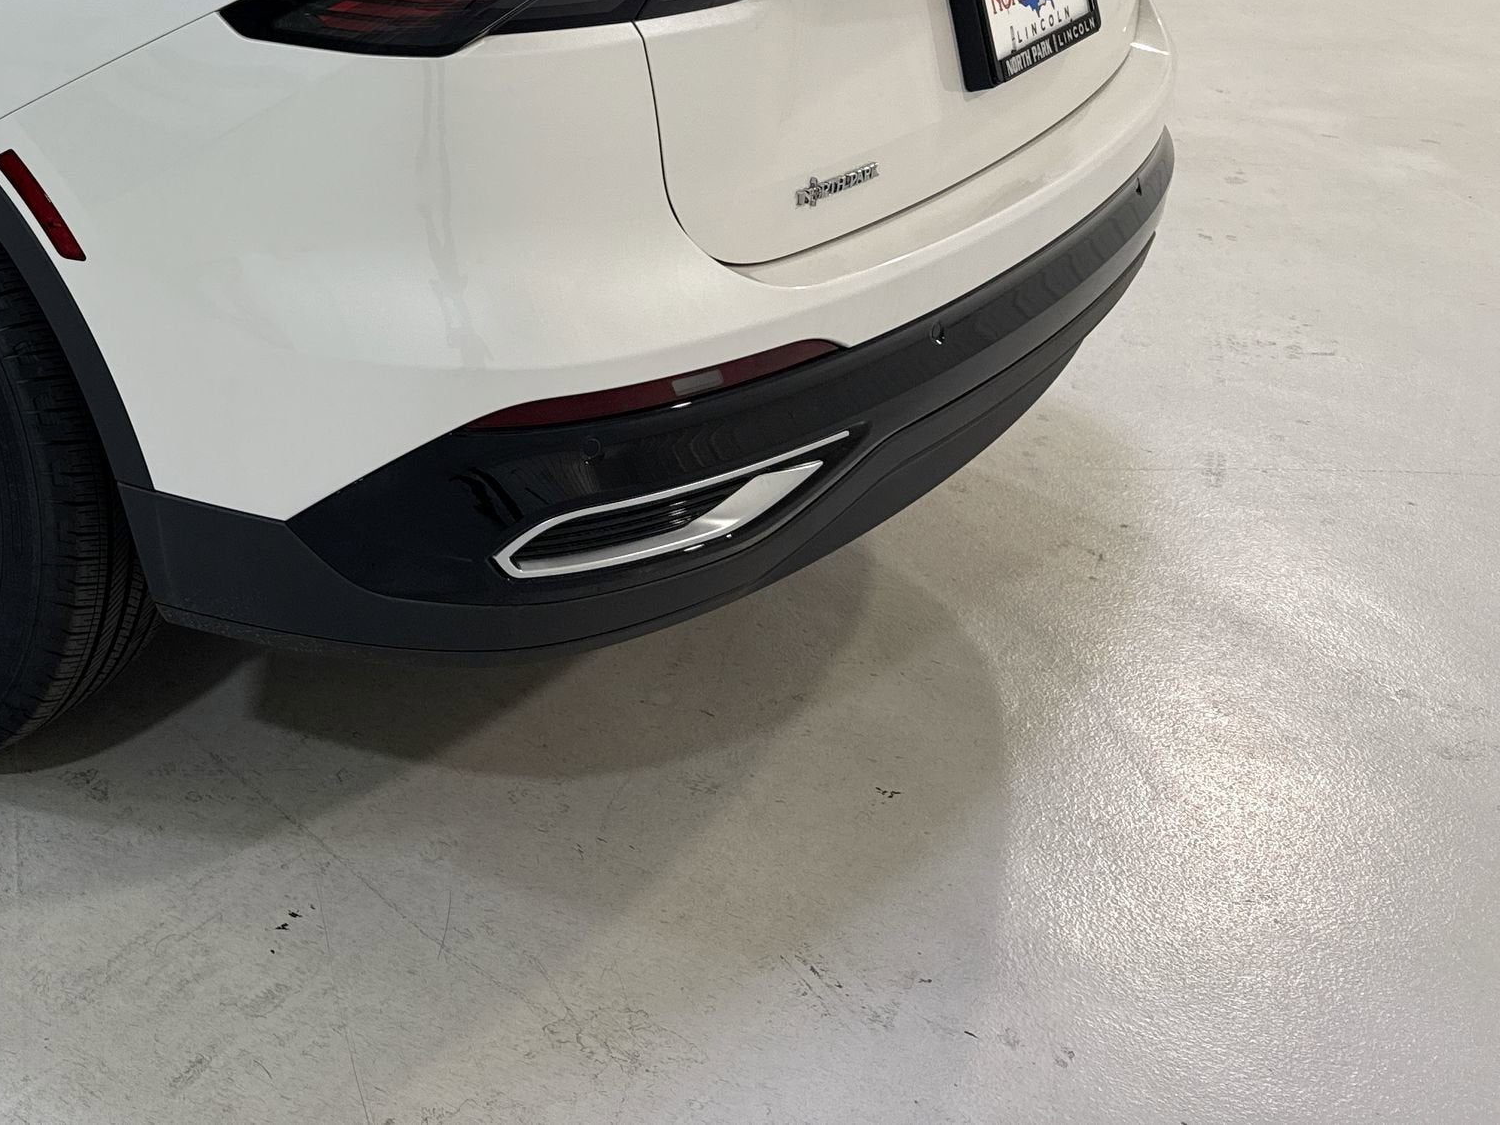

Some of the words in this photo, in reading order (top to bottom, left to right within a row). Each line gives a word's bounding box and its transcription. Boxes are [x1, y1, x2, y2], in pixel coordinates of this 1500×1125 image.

[1005, 49, 1033, 77] NORTH
[1031, 38, 1053, 63] PARK
[1057, 16, 1096, 47] LINCOLN
[1016, 5, 1071, 44] LINCOLN
